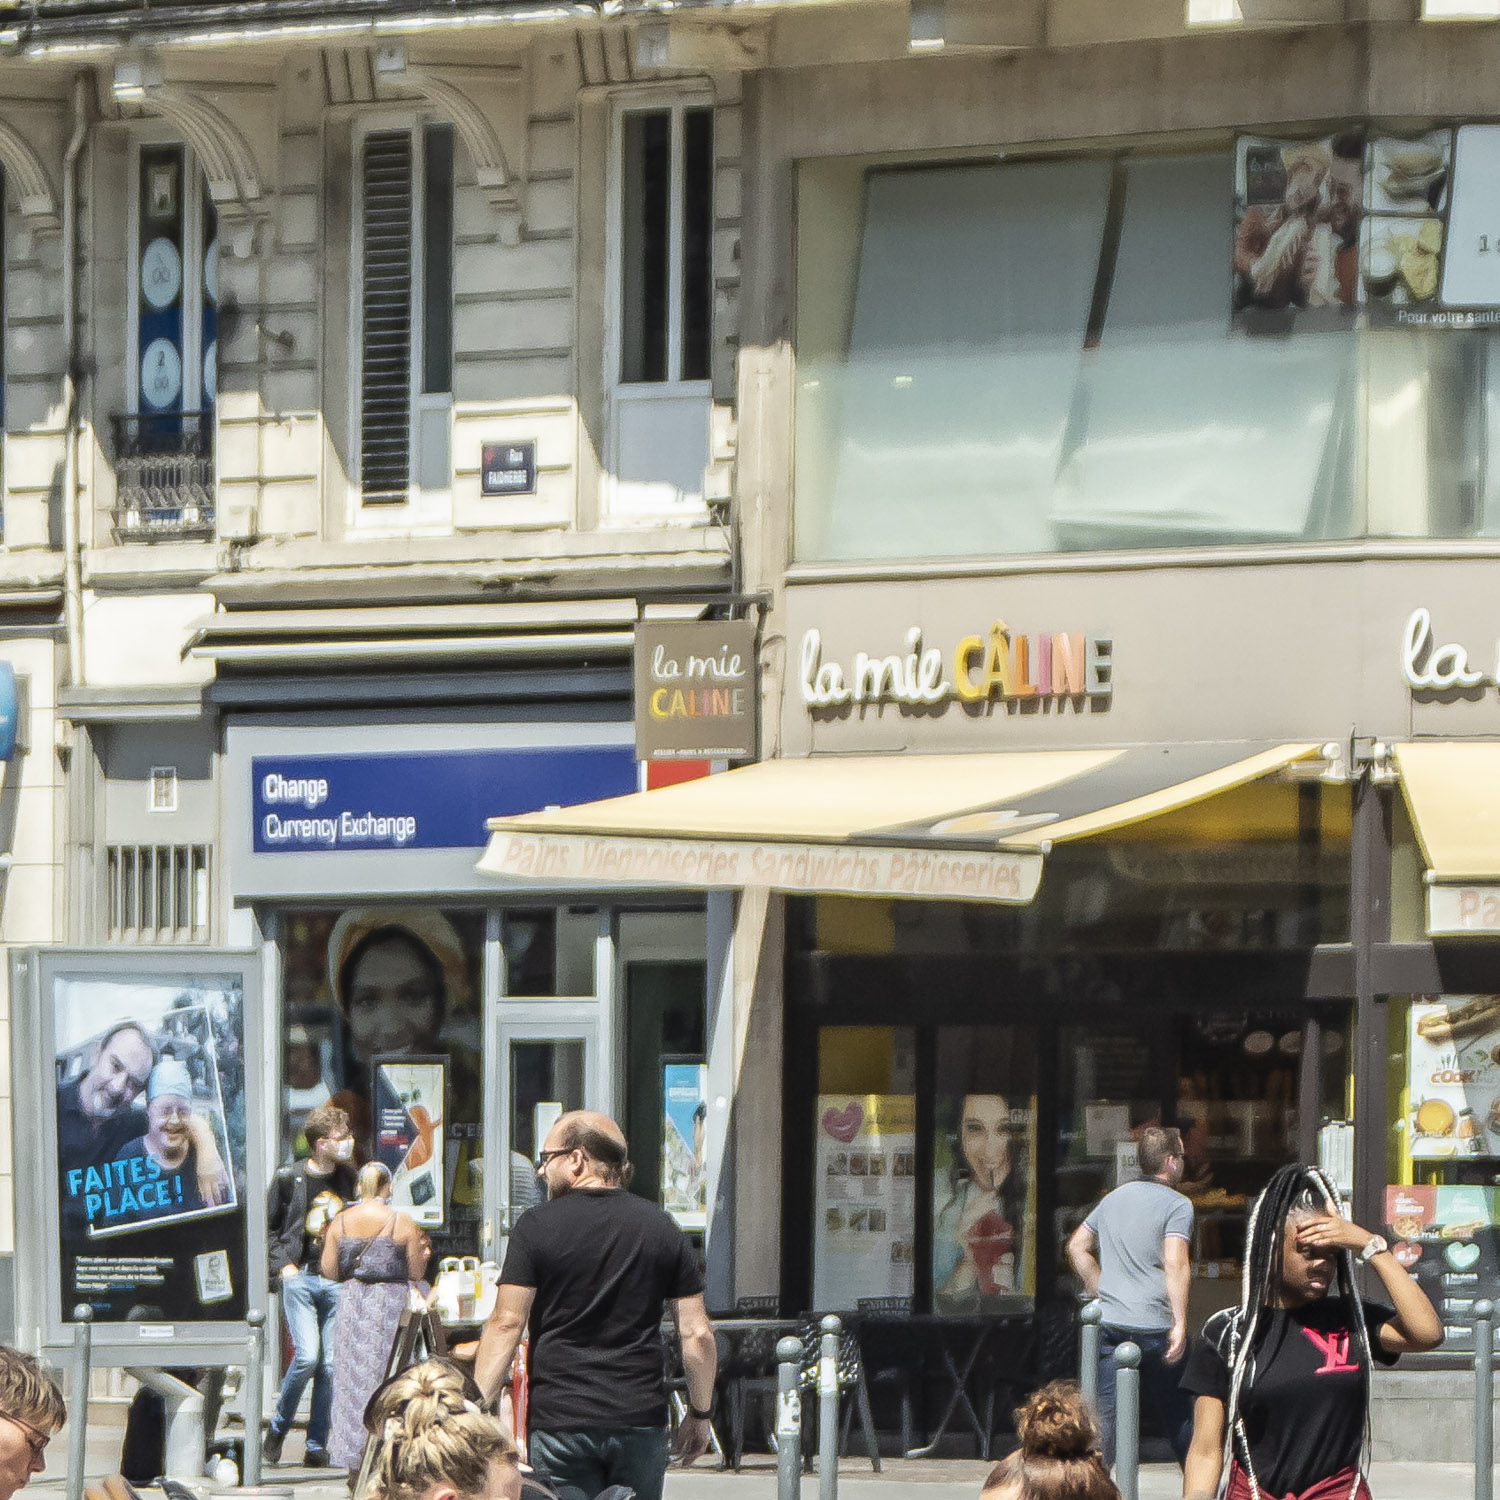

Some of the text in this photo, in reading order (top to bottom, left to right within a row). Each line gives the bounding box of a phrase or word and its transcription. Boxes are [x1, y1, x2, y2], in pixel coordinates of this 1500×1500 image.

[653, 644, 746, 679] la mie
[800, 628, 851, 701] la
[855, 626, 951, 701] mie
[1404, 607, 1483, 686] la
[263, 773, 328, 805] Change
[264, 811, 417, 844] Currency Exchange
[505, 837, 1022, 898] Pains Viennoiseries Sandwichs Pâtisseries
[67, 1154, 162, 1197] FAITES
